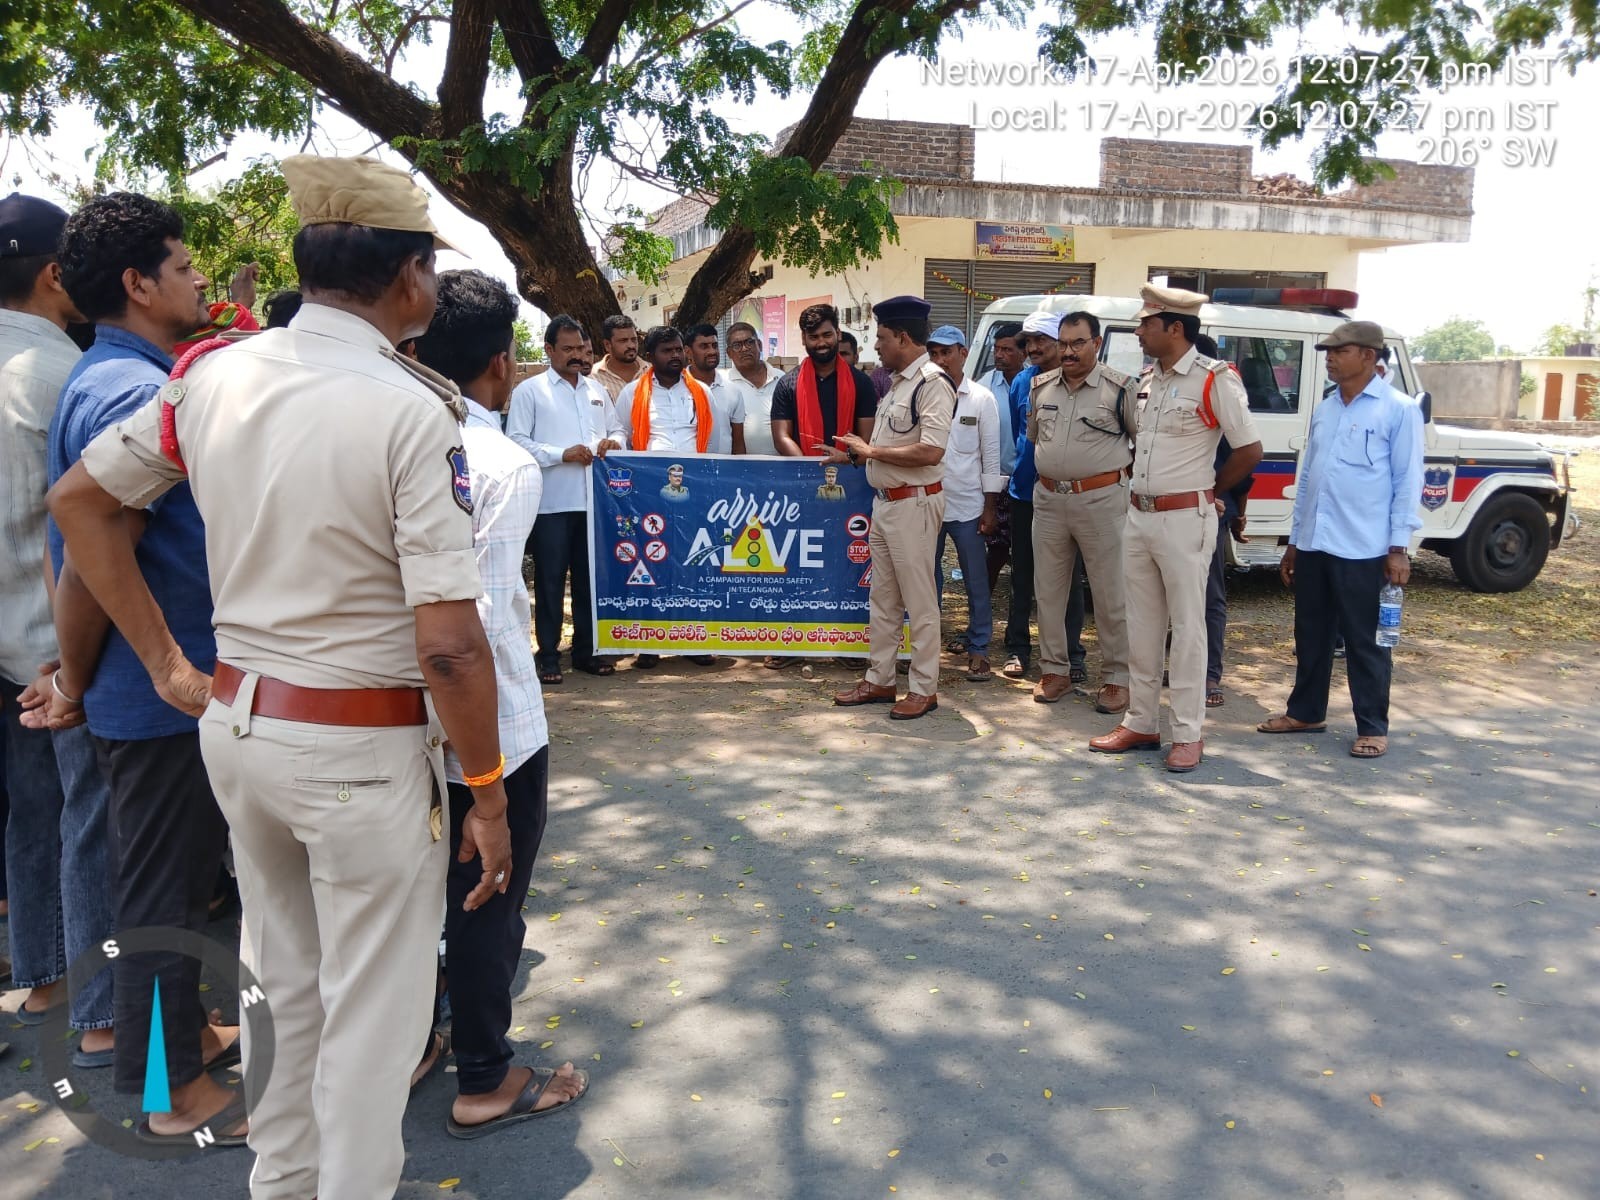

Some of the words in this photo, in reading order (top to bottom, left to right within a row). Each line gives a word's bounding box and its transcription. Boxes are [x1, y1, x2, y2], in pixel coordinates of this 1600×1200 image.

[1423, 487, 1447, 496] POLICE
[706, 488, 801, 529] arrive
[849, 545, 869, 554] STOP
[705, 576, 746, 584] CAMPAIGN
[763, 577, 785, 585] ROAD
[786, 577, 814, 585] SAFETY
